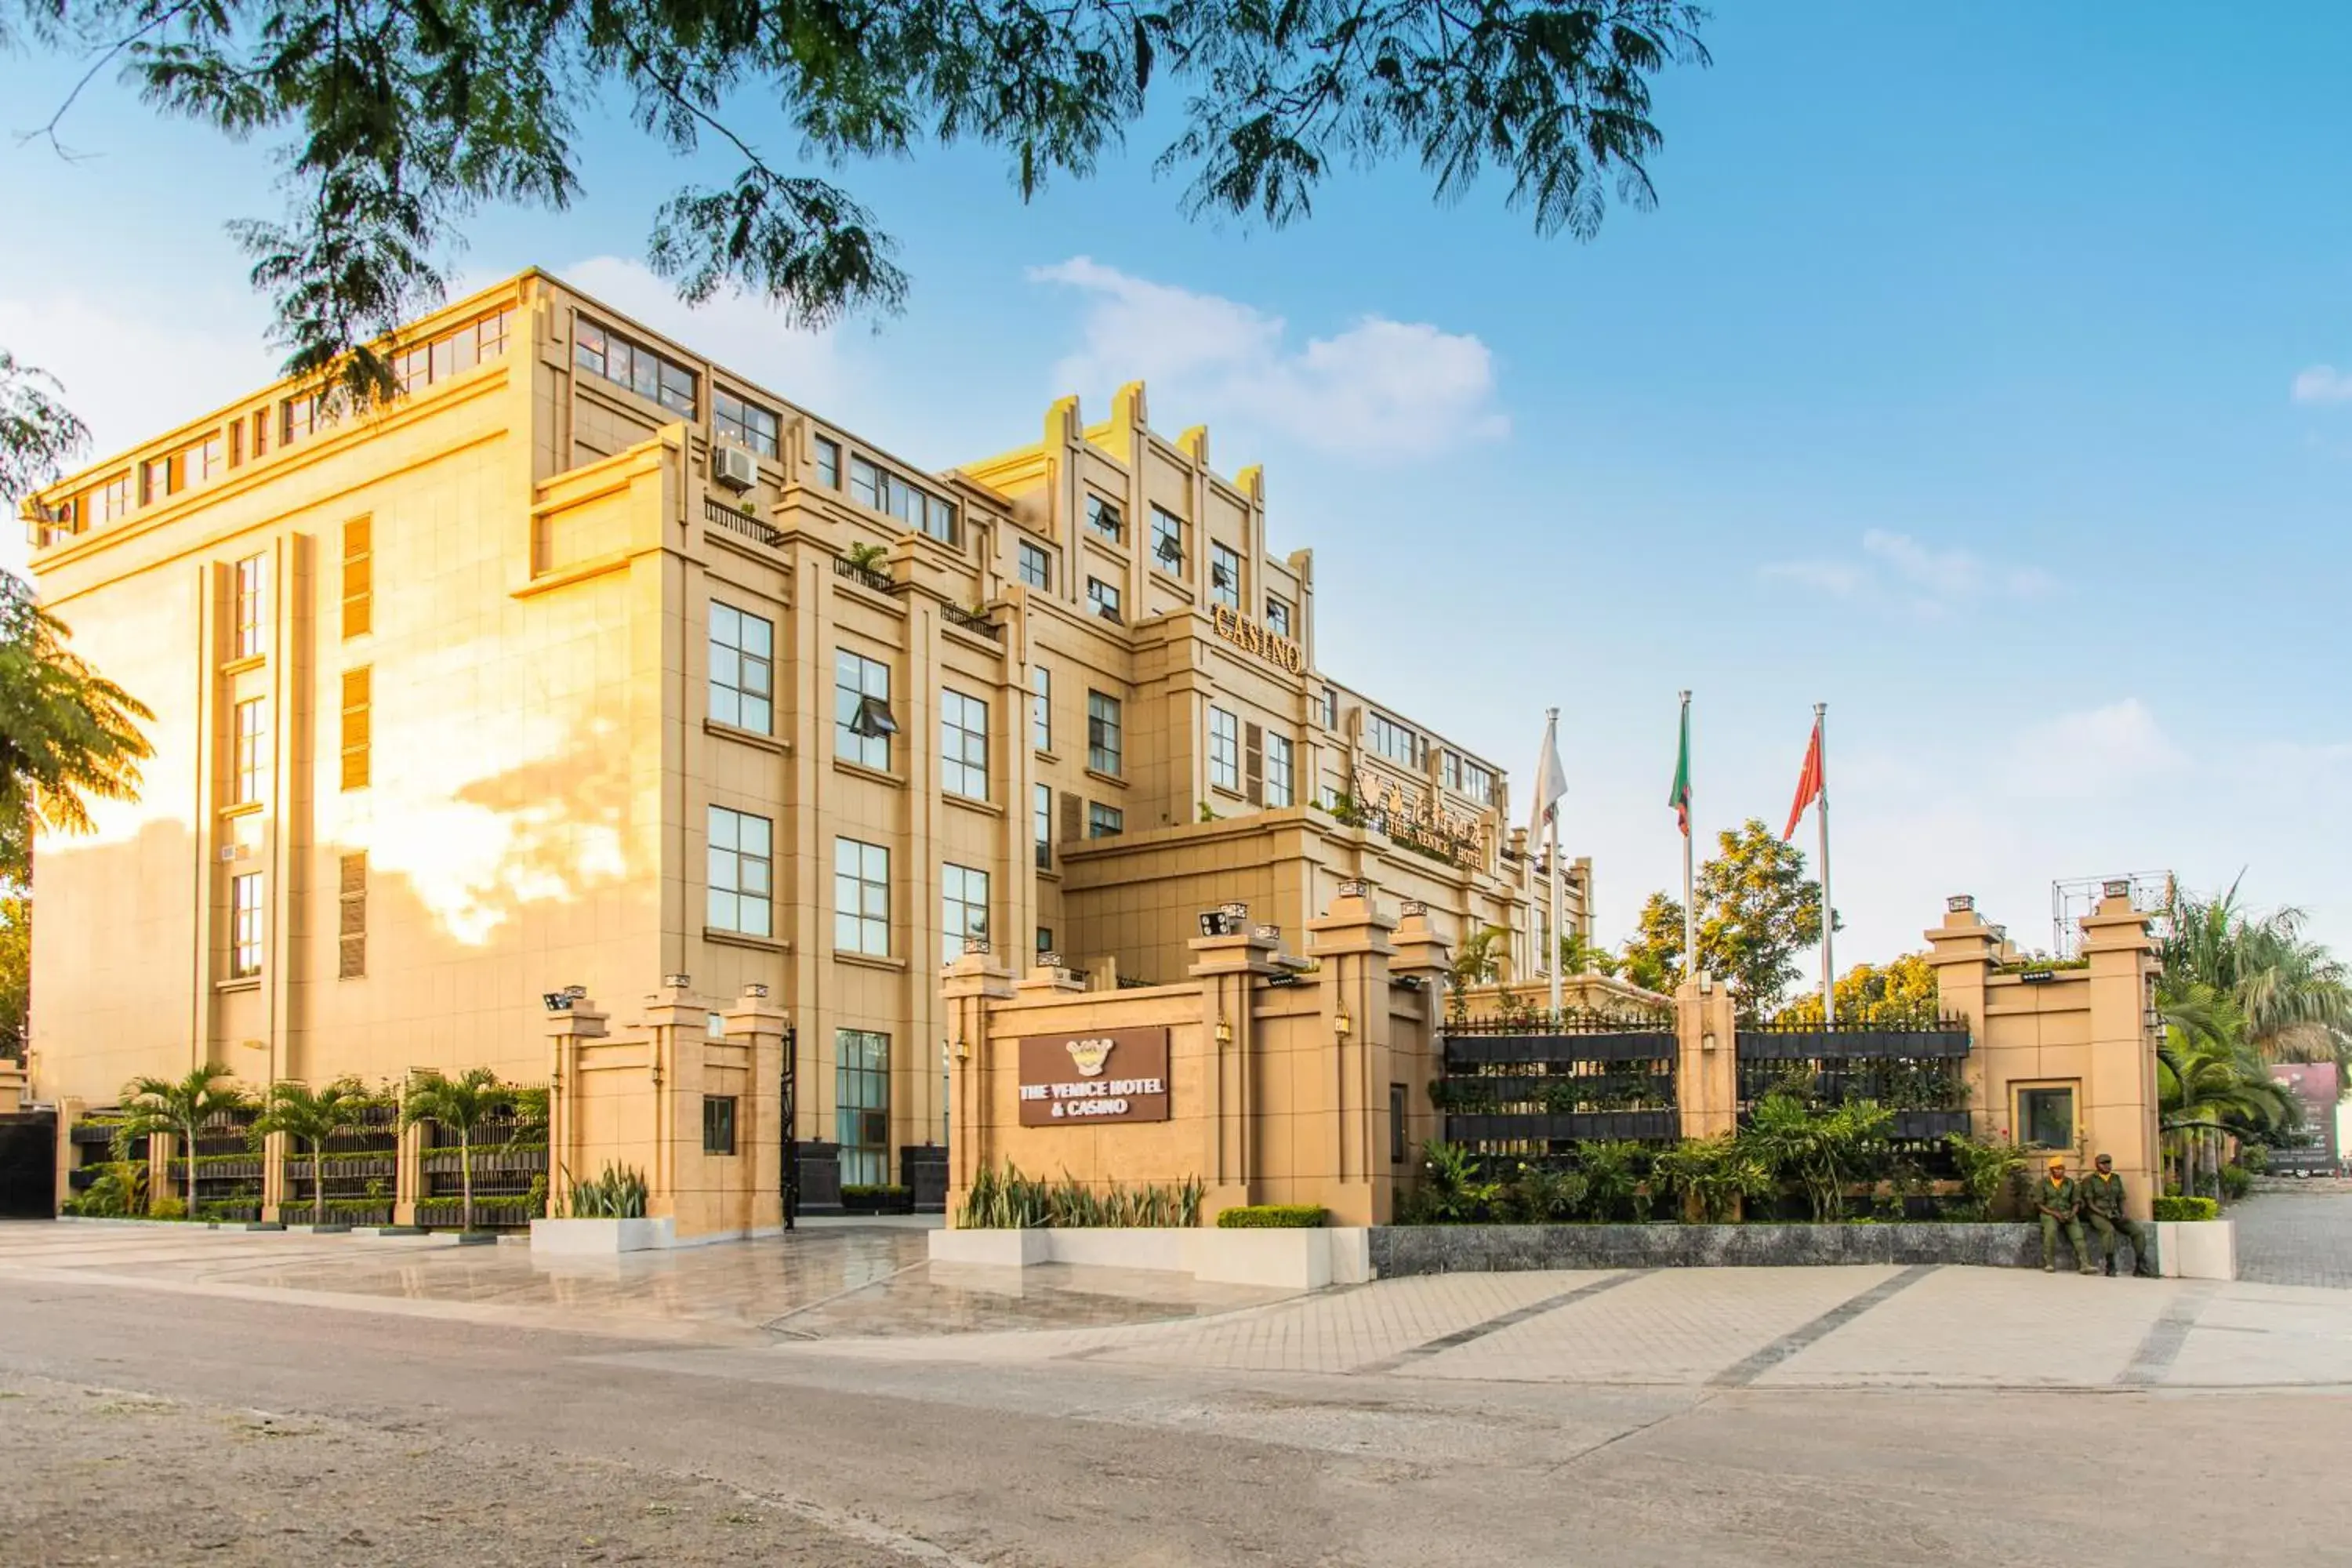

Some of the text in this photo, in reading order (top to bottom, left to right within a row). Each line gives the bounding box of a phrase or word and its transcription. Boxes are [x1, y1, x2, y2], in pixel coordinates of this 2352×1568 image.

[1216, 604, 1302, 676] CASINO
[1388, 818, 1483, 871] THE VENICE HOTEL
[1020, 1078, 1163, 1100] THE VENICE HOTEL
[1051, 1098, 1128, 1117] & CASINO
